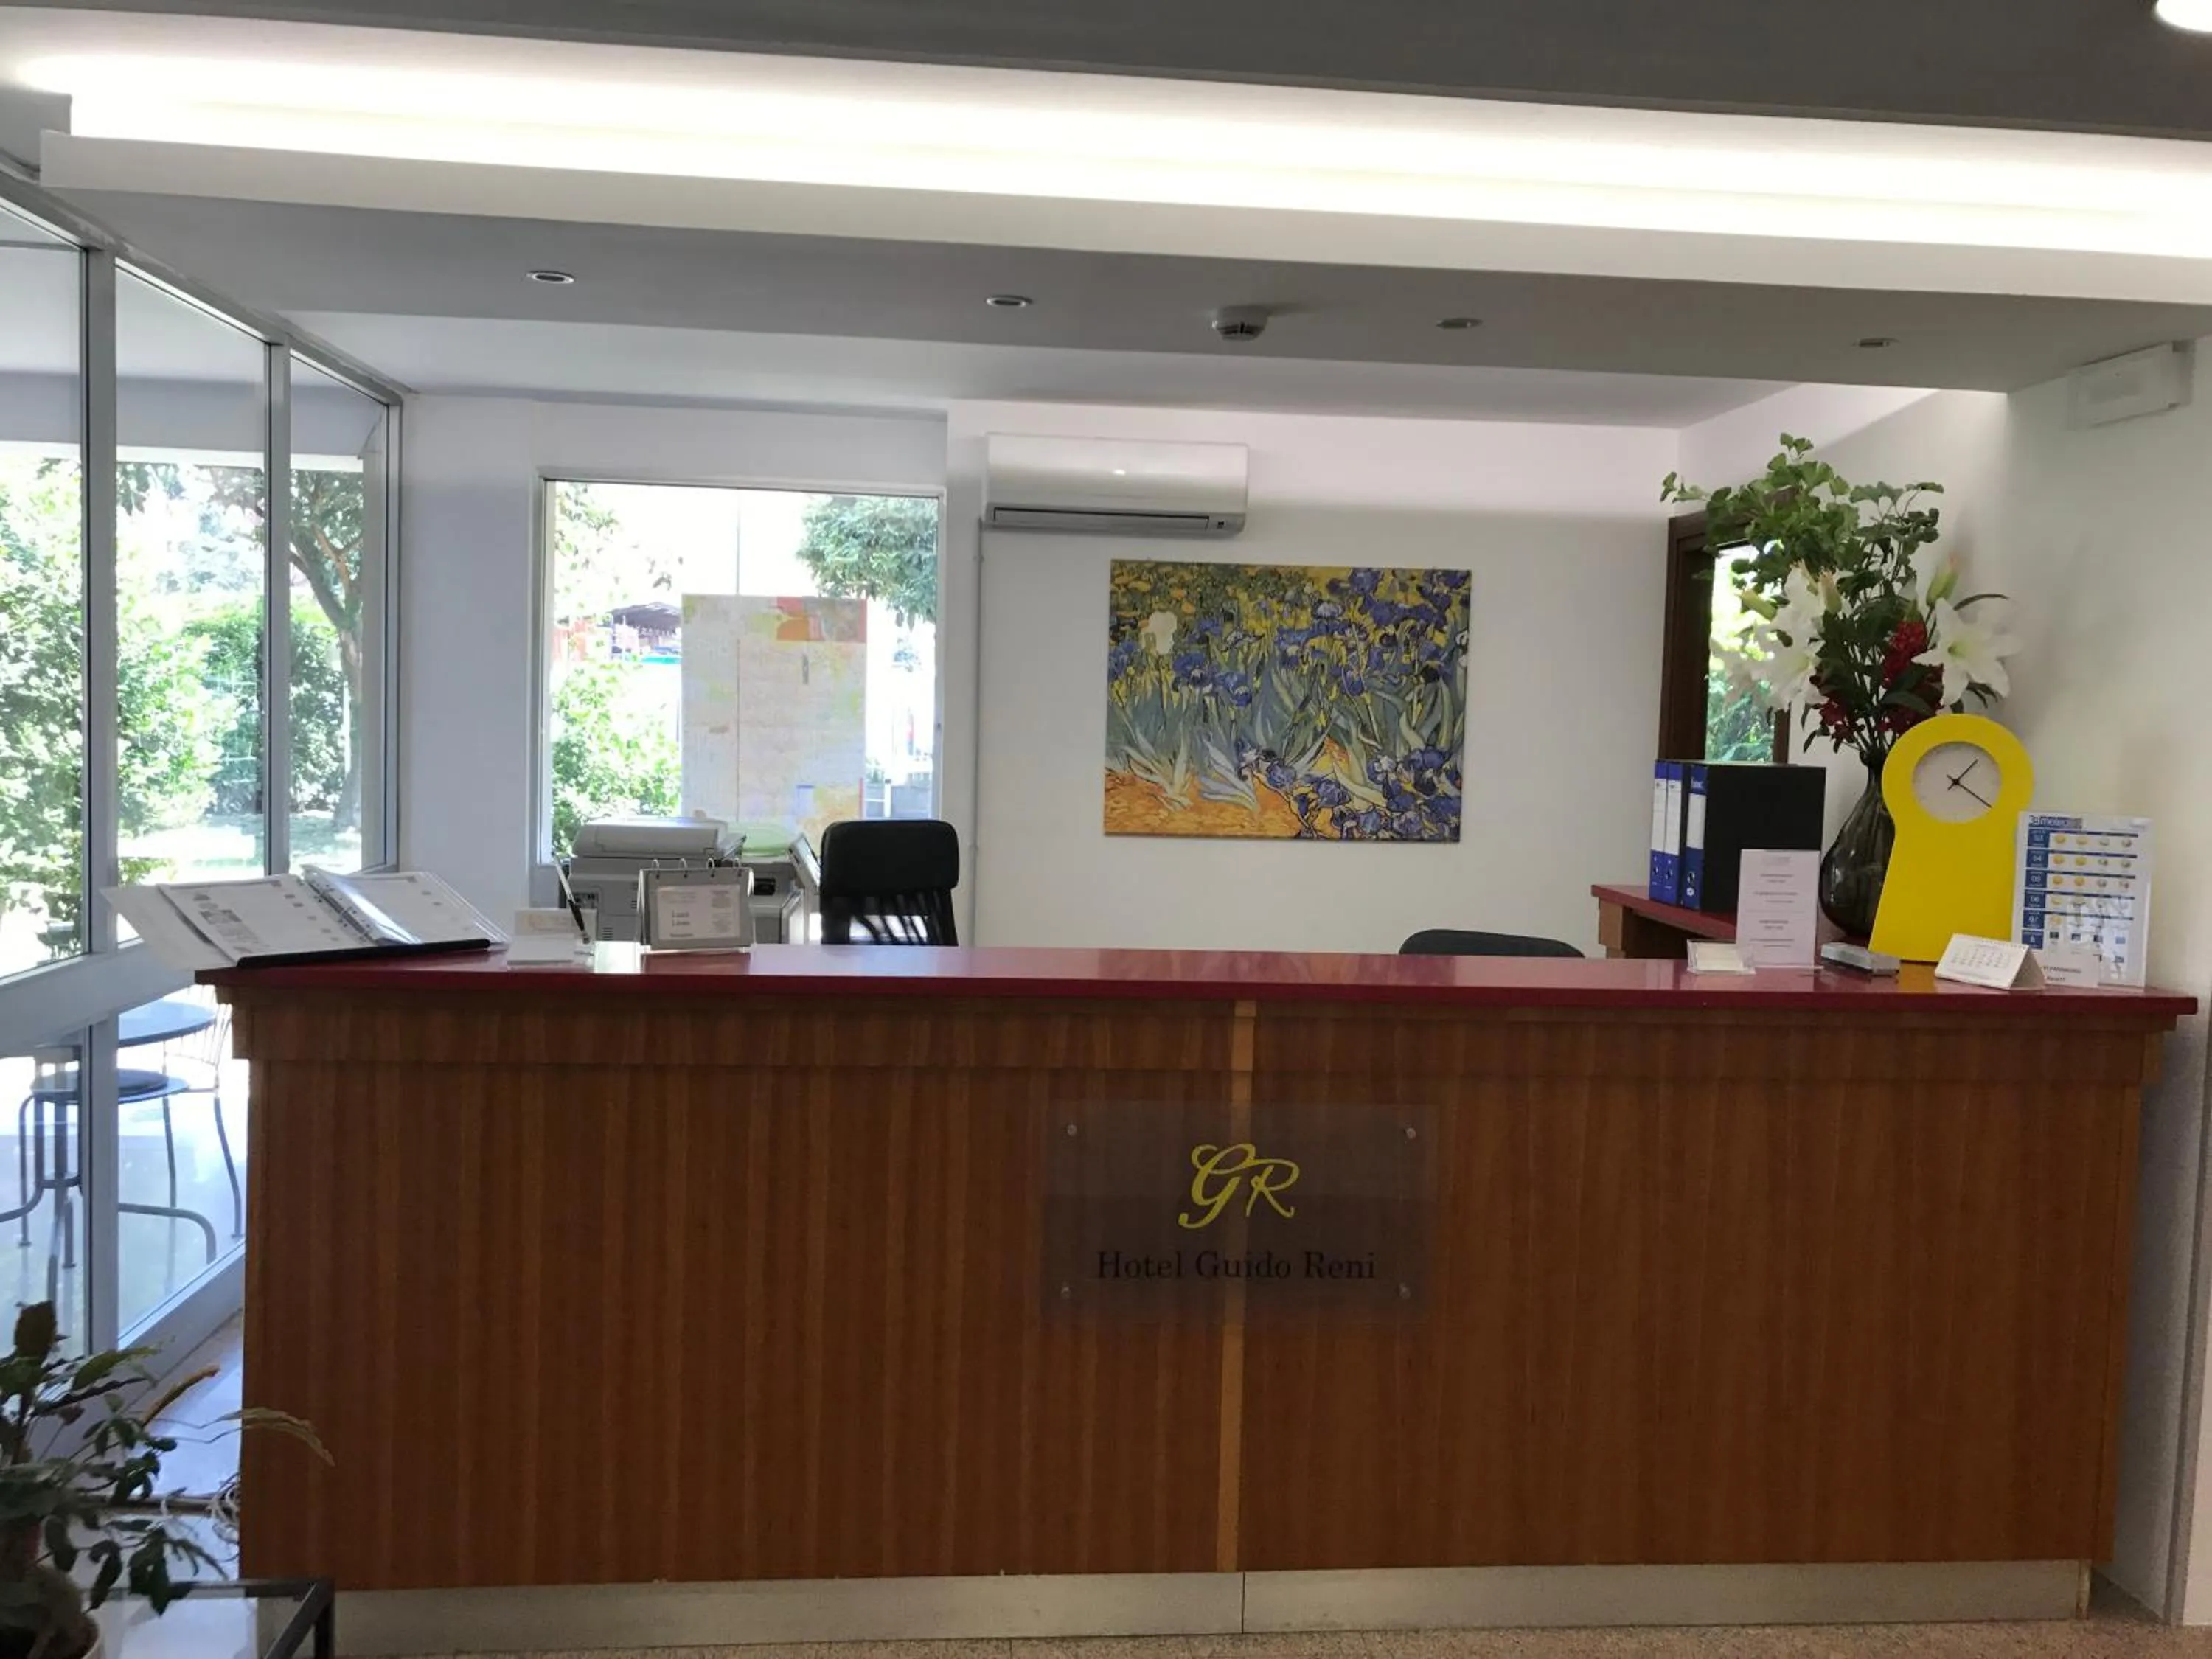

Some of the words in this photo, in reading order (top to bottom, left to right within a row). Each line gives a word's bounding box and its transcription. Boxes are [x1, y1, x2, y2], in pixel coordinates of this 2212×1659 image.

[1178, 1143, 1300, 1229] GR
[1096, 1251, 1183, 1279] Hotel
[1194, 1251, 1293, 1279] Guido
[1304, 1251, 1376, 1279] Reni
